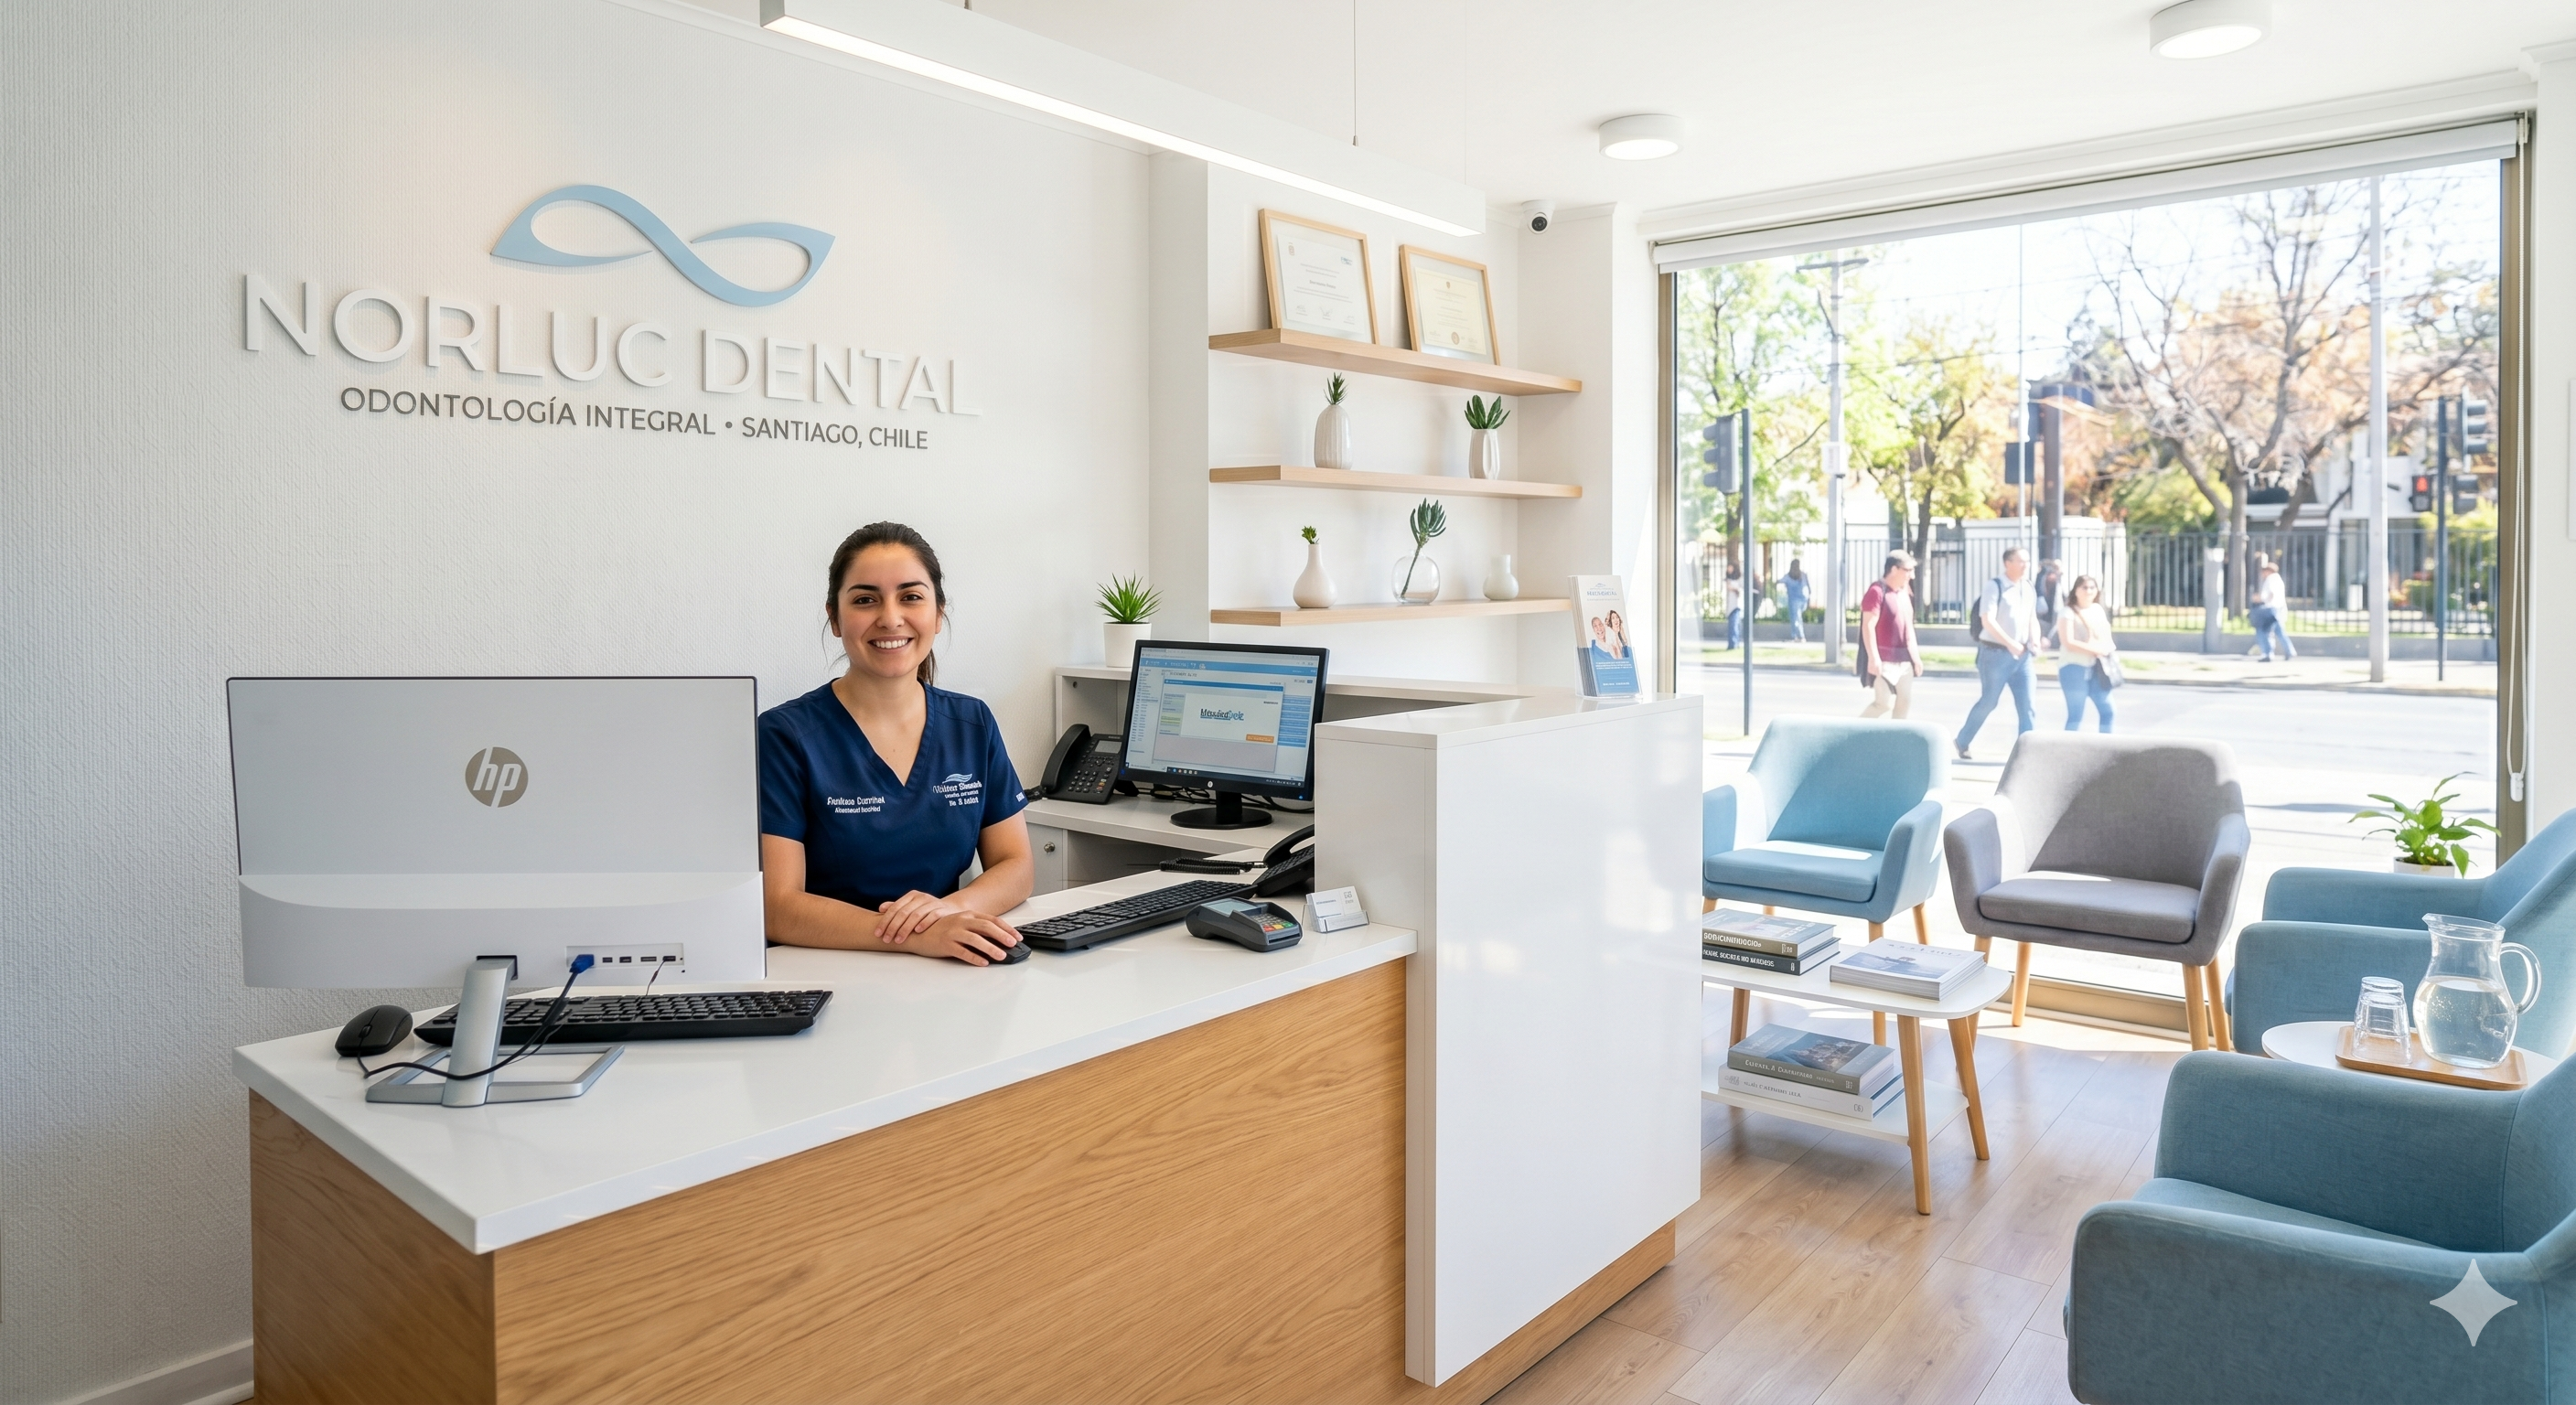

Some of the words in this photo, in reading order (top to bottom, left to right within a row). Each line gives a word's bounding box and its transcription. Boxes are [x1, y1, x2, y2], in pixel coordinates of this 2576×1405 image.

[245, 273, 673, 388] NORLUC
[702, 328, 984, 417] DENTAL
[340, 386, 577, 427] ODONTOLOGÍA
[586, 404, 717, 436] INTEGRAL
[742, 415, 864, 449] SANTIAGO,
[868, 425, 929, 450] CHILE
